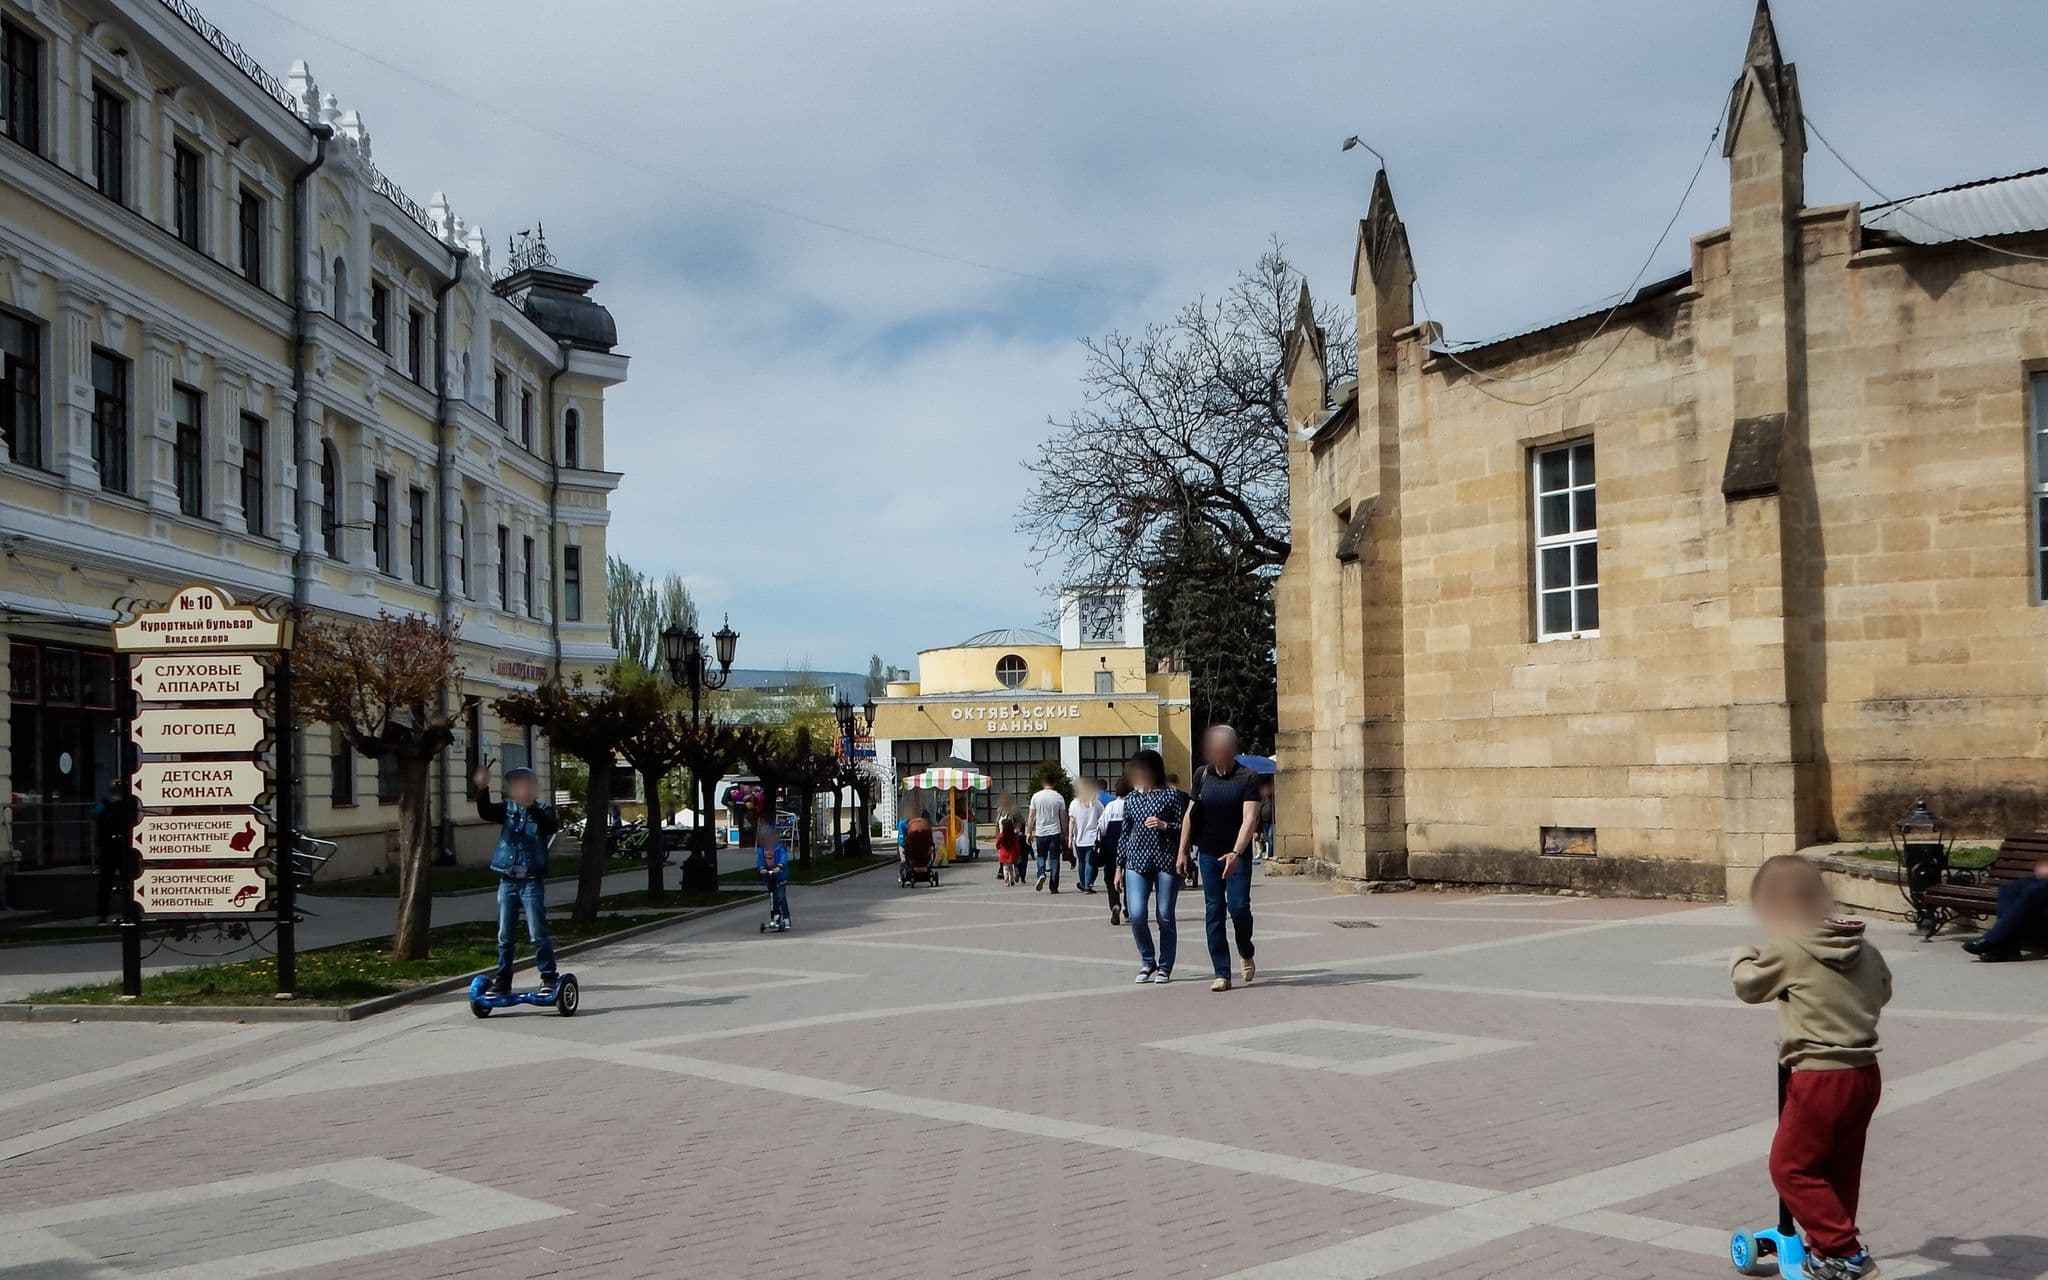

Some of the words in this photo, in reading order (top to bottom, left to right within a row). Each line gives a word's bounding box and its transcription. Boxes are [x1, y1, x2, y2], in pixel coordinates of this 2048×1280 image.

[180, 595, 195, 610] №
[198, 595, 213, 610] 10
[140, 618, 203, 632] Курортный
[206, 618, 253, 630] бульвар
[165, 634, 188, 644] Вход
[188, 635, 199, 643] со
[200, 634, 229, 644] двора
[155, 664, 242, 676] СЛУХОВЫЕ
[157, 681, 239, 693] АППАРАТЫ
[951, 705, 1080, 720] ОКТЯБРЬСКИЕ
[161, 723, 236, 737] ЛОГОПЕД
[987, 720, 1048, 732] ВАННЫ
[161, 770, 233, 784] ДЕТСКАЯ
[161, 786, 233, 799] КОМНАТА
[149, 821, 233, 831] ЭКЗОТИЧЕСКИЕ
[149, 834, 157, 842] И
[158, 832, 229, 842] КОНТАКТНЫЕ
[149, 844, 212, 854] ЖИВОТНЫЕ
[151, 875, 234, 884] ЭКЗОТИЧЕСКИЕ
[151, 887, 159, 895] И
[161, 886, 232, 895] КОНТАКТНЫЕ
[151, 898, 214, 907] ЖИВОТНЫЕ
